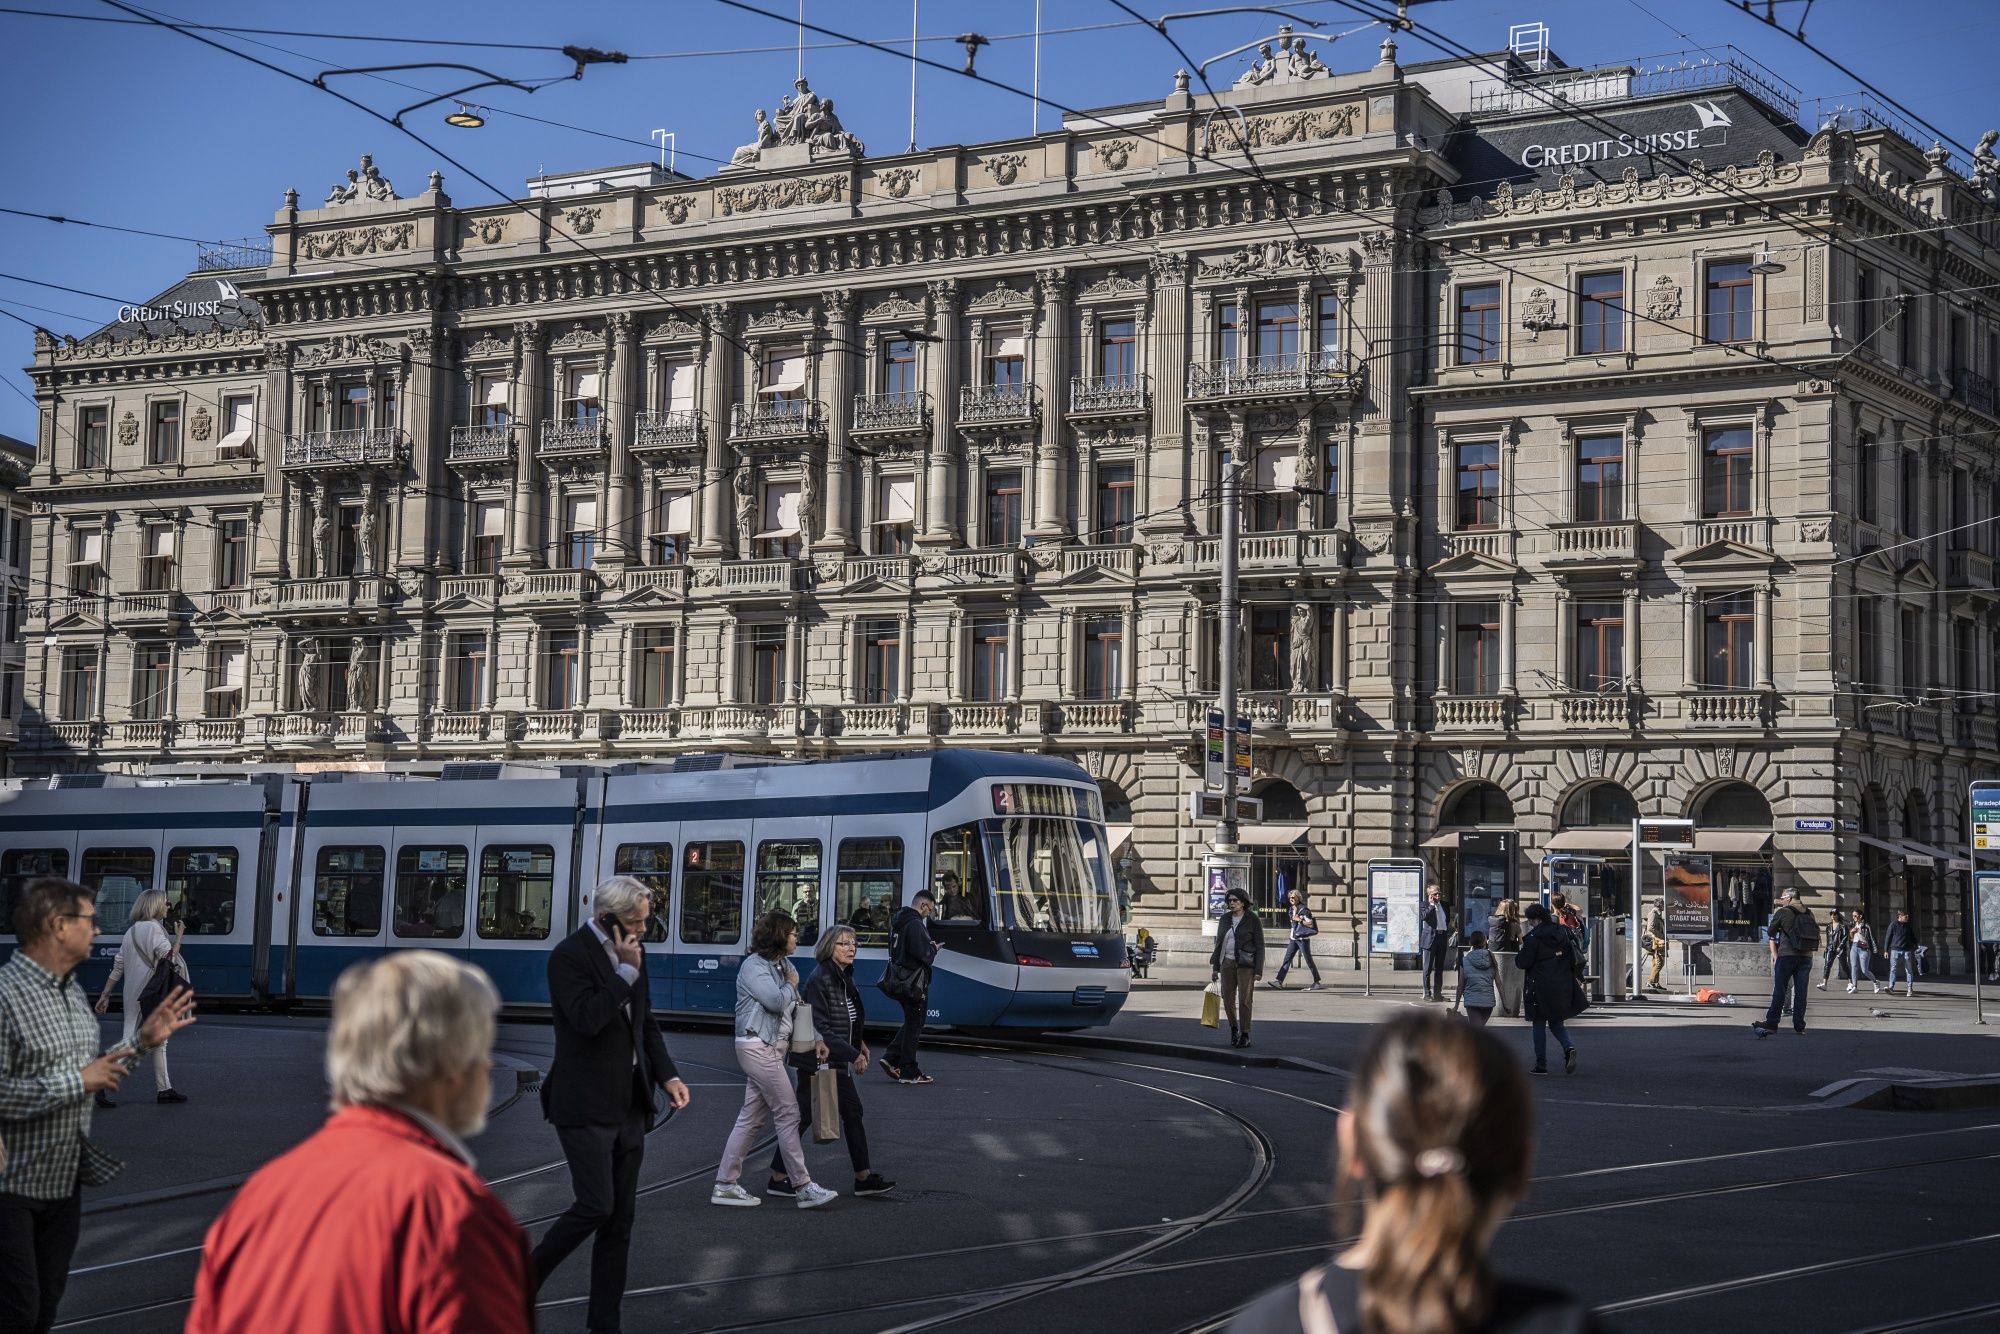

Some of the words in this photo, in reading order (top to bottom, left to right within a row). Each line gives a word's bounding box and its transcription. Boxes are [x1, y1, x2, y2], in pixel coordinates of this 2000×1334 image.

[1521, 140, 1613, 168] CREDIT
[1617, 129, 1700, 157] SUISSE
[117, 304, 172, 323] CREDIT
[173, 300, 221, 319] SUISSE
[1000, 790, 1009, 806] 2
[1978, 813, 1987, 821] 11
[1800, 820, 1827, 829] Paradeplatz
[691, 851, 698, 863] 2
